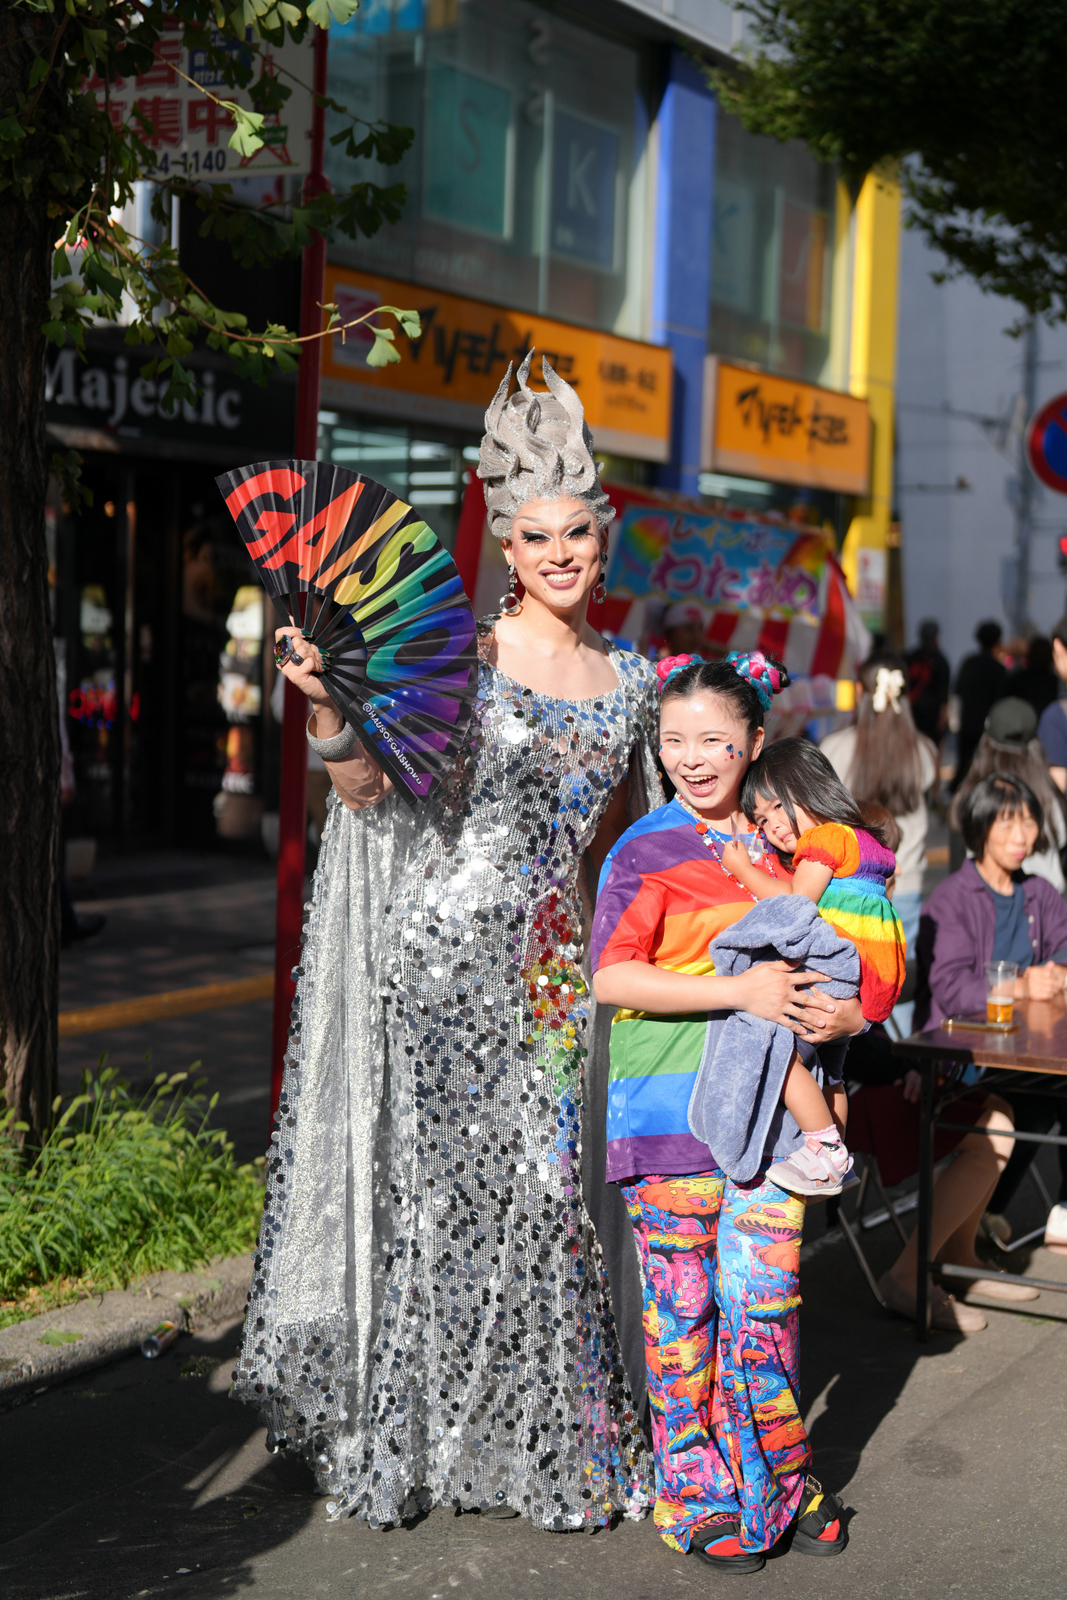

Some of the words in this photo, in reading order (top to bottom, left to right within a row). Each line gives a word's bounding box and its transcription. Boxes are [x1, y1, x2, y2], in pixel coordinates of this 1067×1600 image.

[650, 551, 817, 607] わたあめ
[225, 468, 477, 796] GAISHOKU
[362, 702, 422, 785] @HAUSOFGAISHOKU
